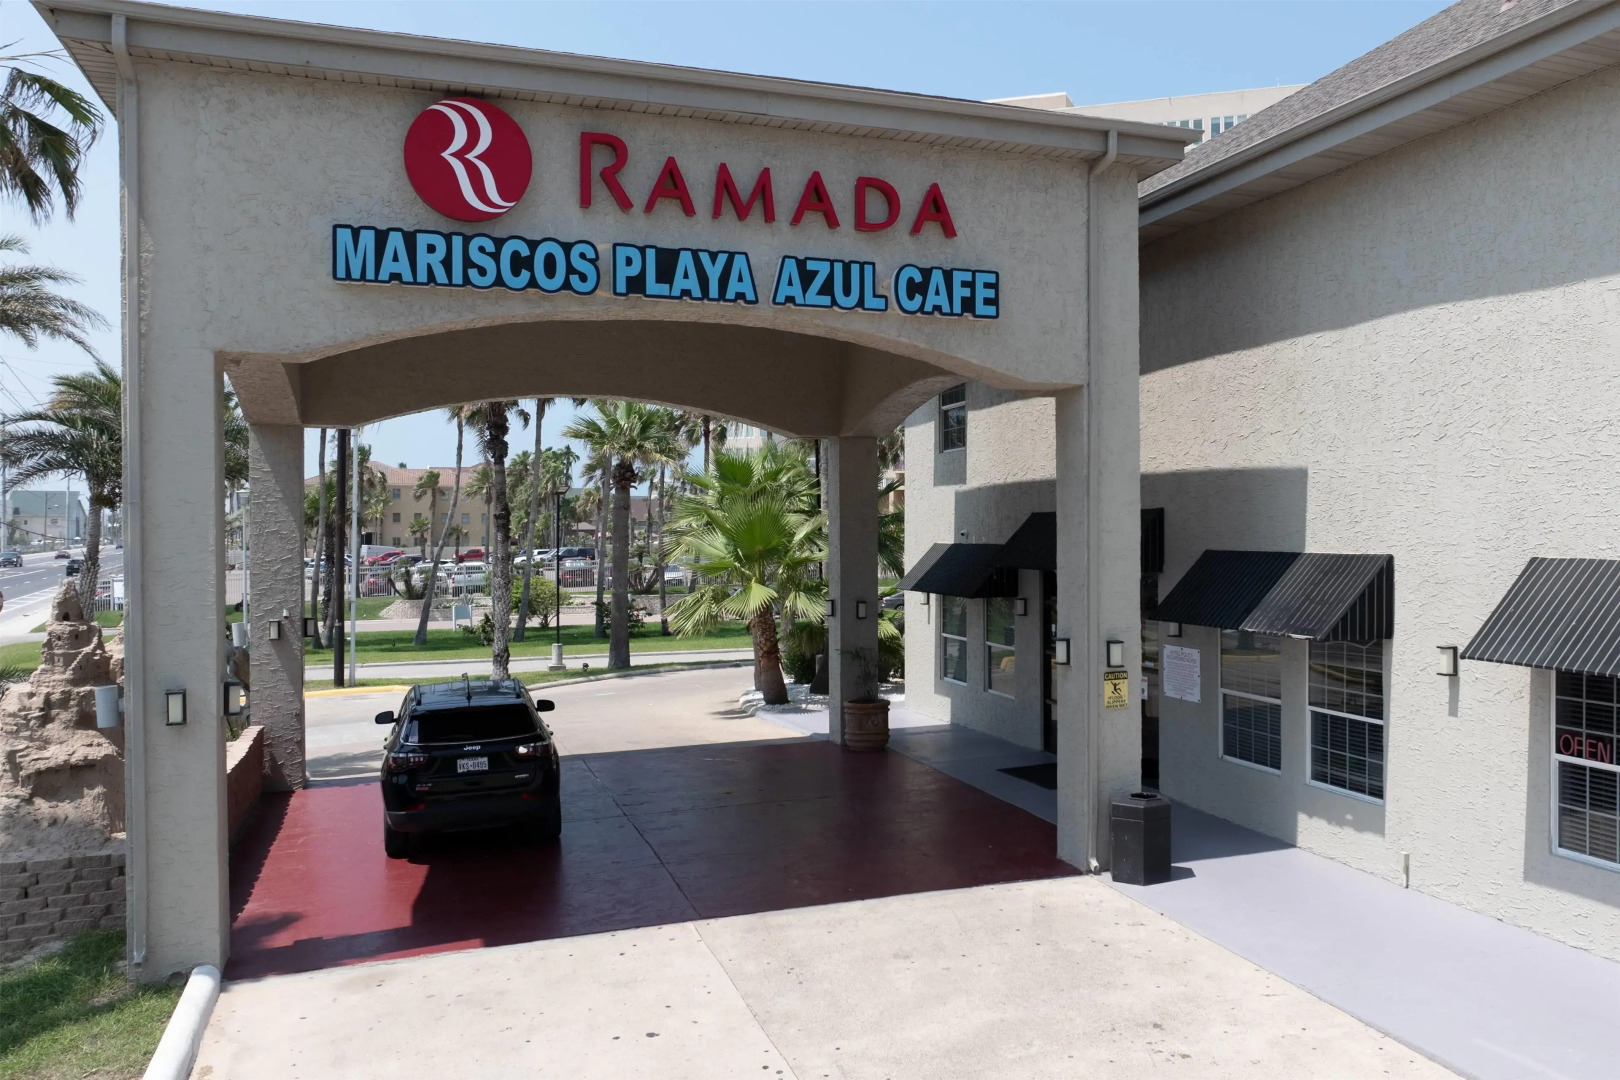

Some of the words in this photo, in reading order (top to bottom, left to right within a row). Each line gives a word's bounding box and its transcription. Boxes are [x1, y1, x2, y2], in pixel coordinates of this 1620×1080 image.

[579, 131, 958, 239] RAMADA
[334, 226, 599, 294] MARISCOS
[614, 244, 757, 302] PLAYA
[773, 257, 888, 311] AZUL
[896, 265, 998, 317] CAFE
[1104, 672, 1128, 680] CAUTION
[1560, 734, 1610, 764] OPEN
